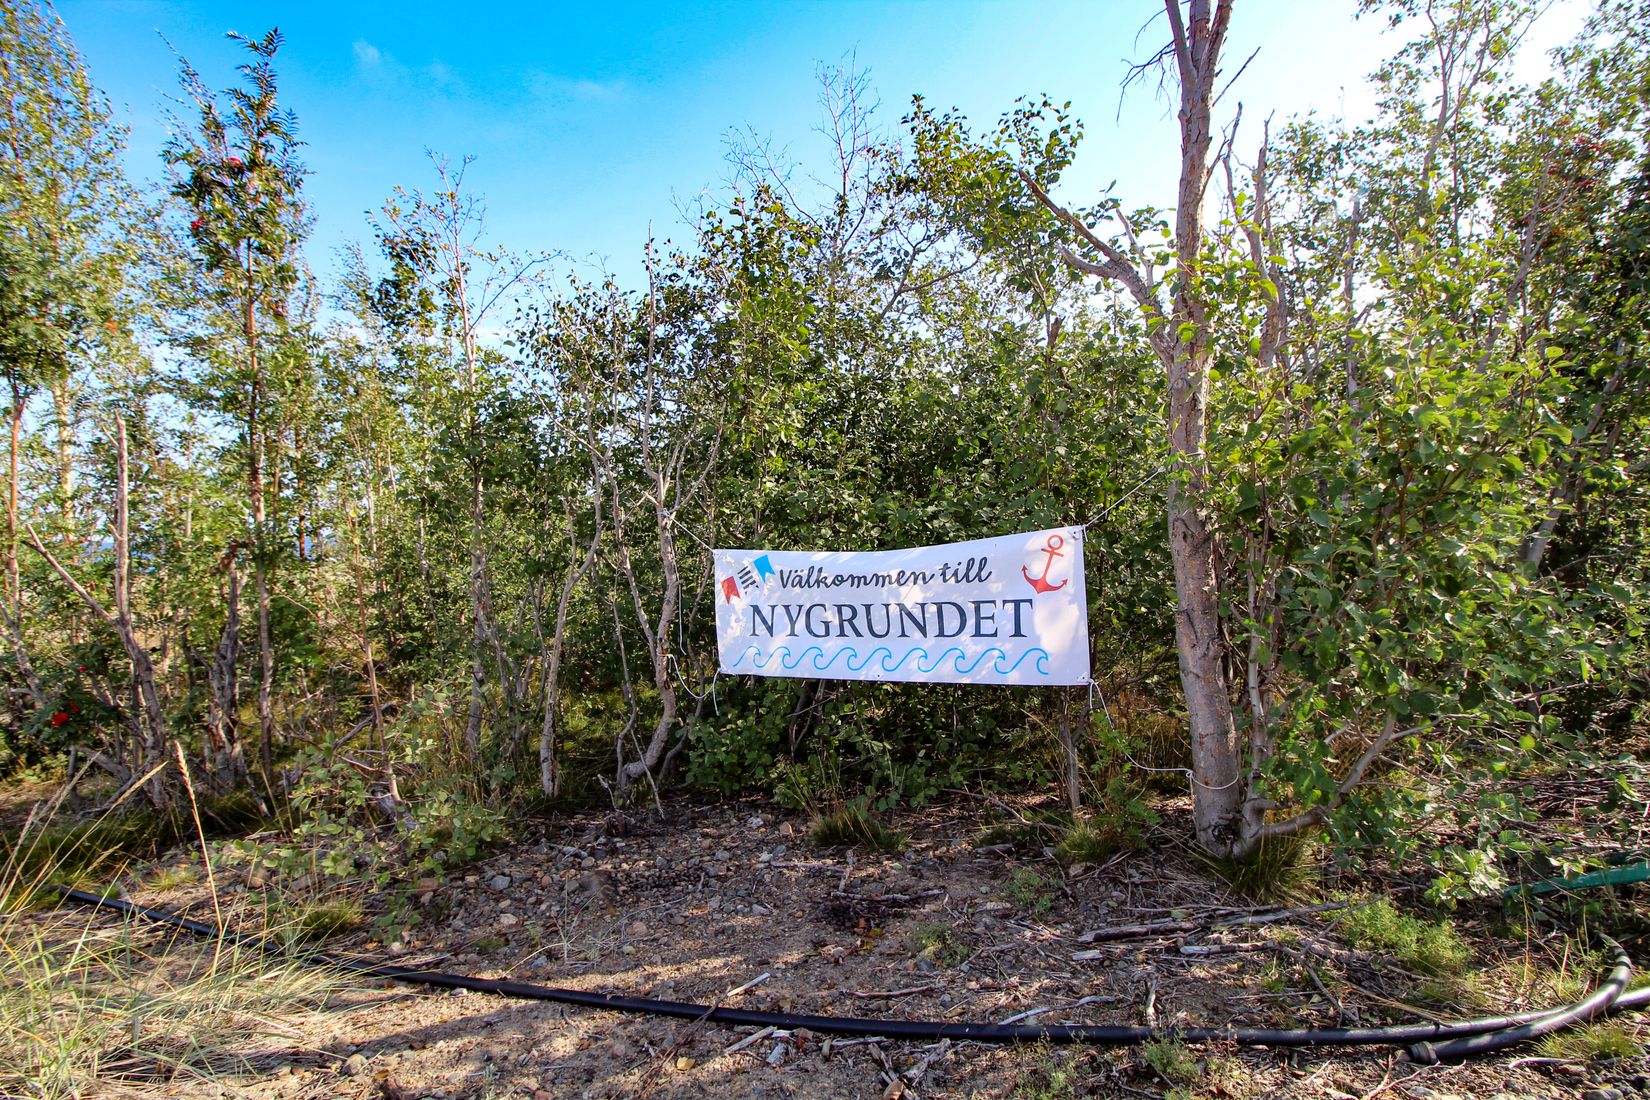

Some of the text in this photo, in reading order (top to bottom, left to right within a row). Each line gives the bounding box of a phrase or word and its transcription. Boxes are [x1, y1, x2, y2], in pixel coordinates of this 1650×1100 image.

[779, 556, 993, 590] Välkommen till
[749, 598, 1033, 639] NYGRUNDET
